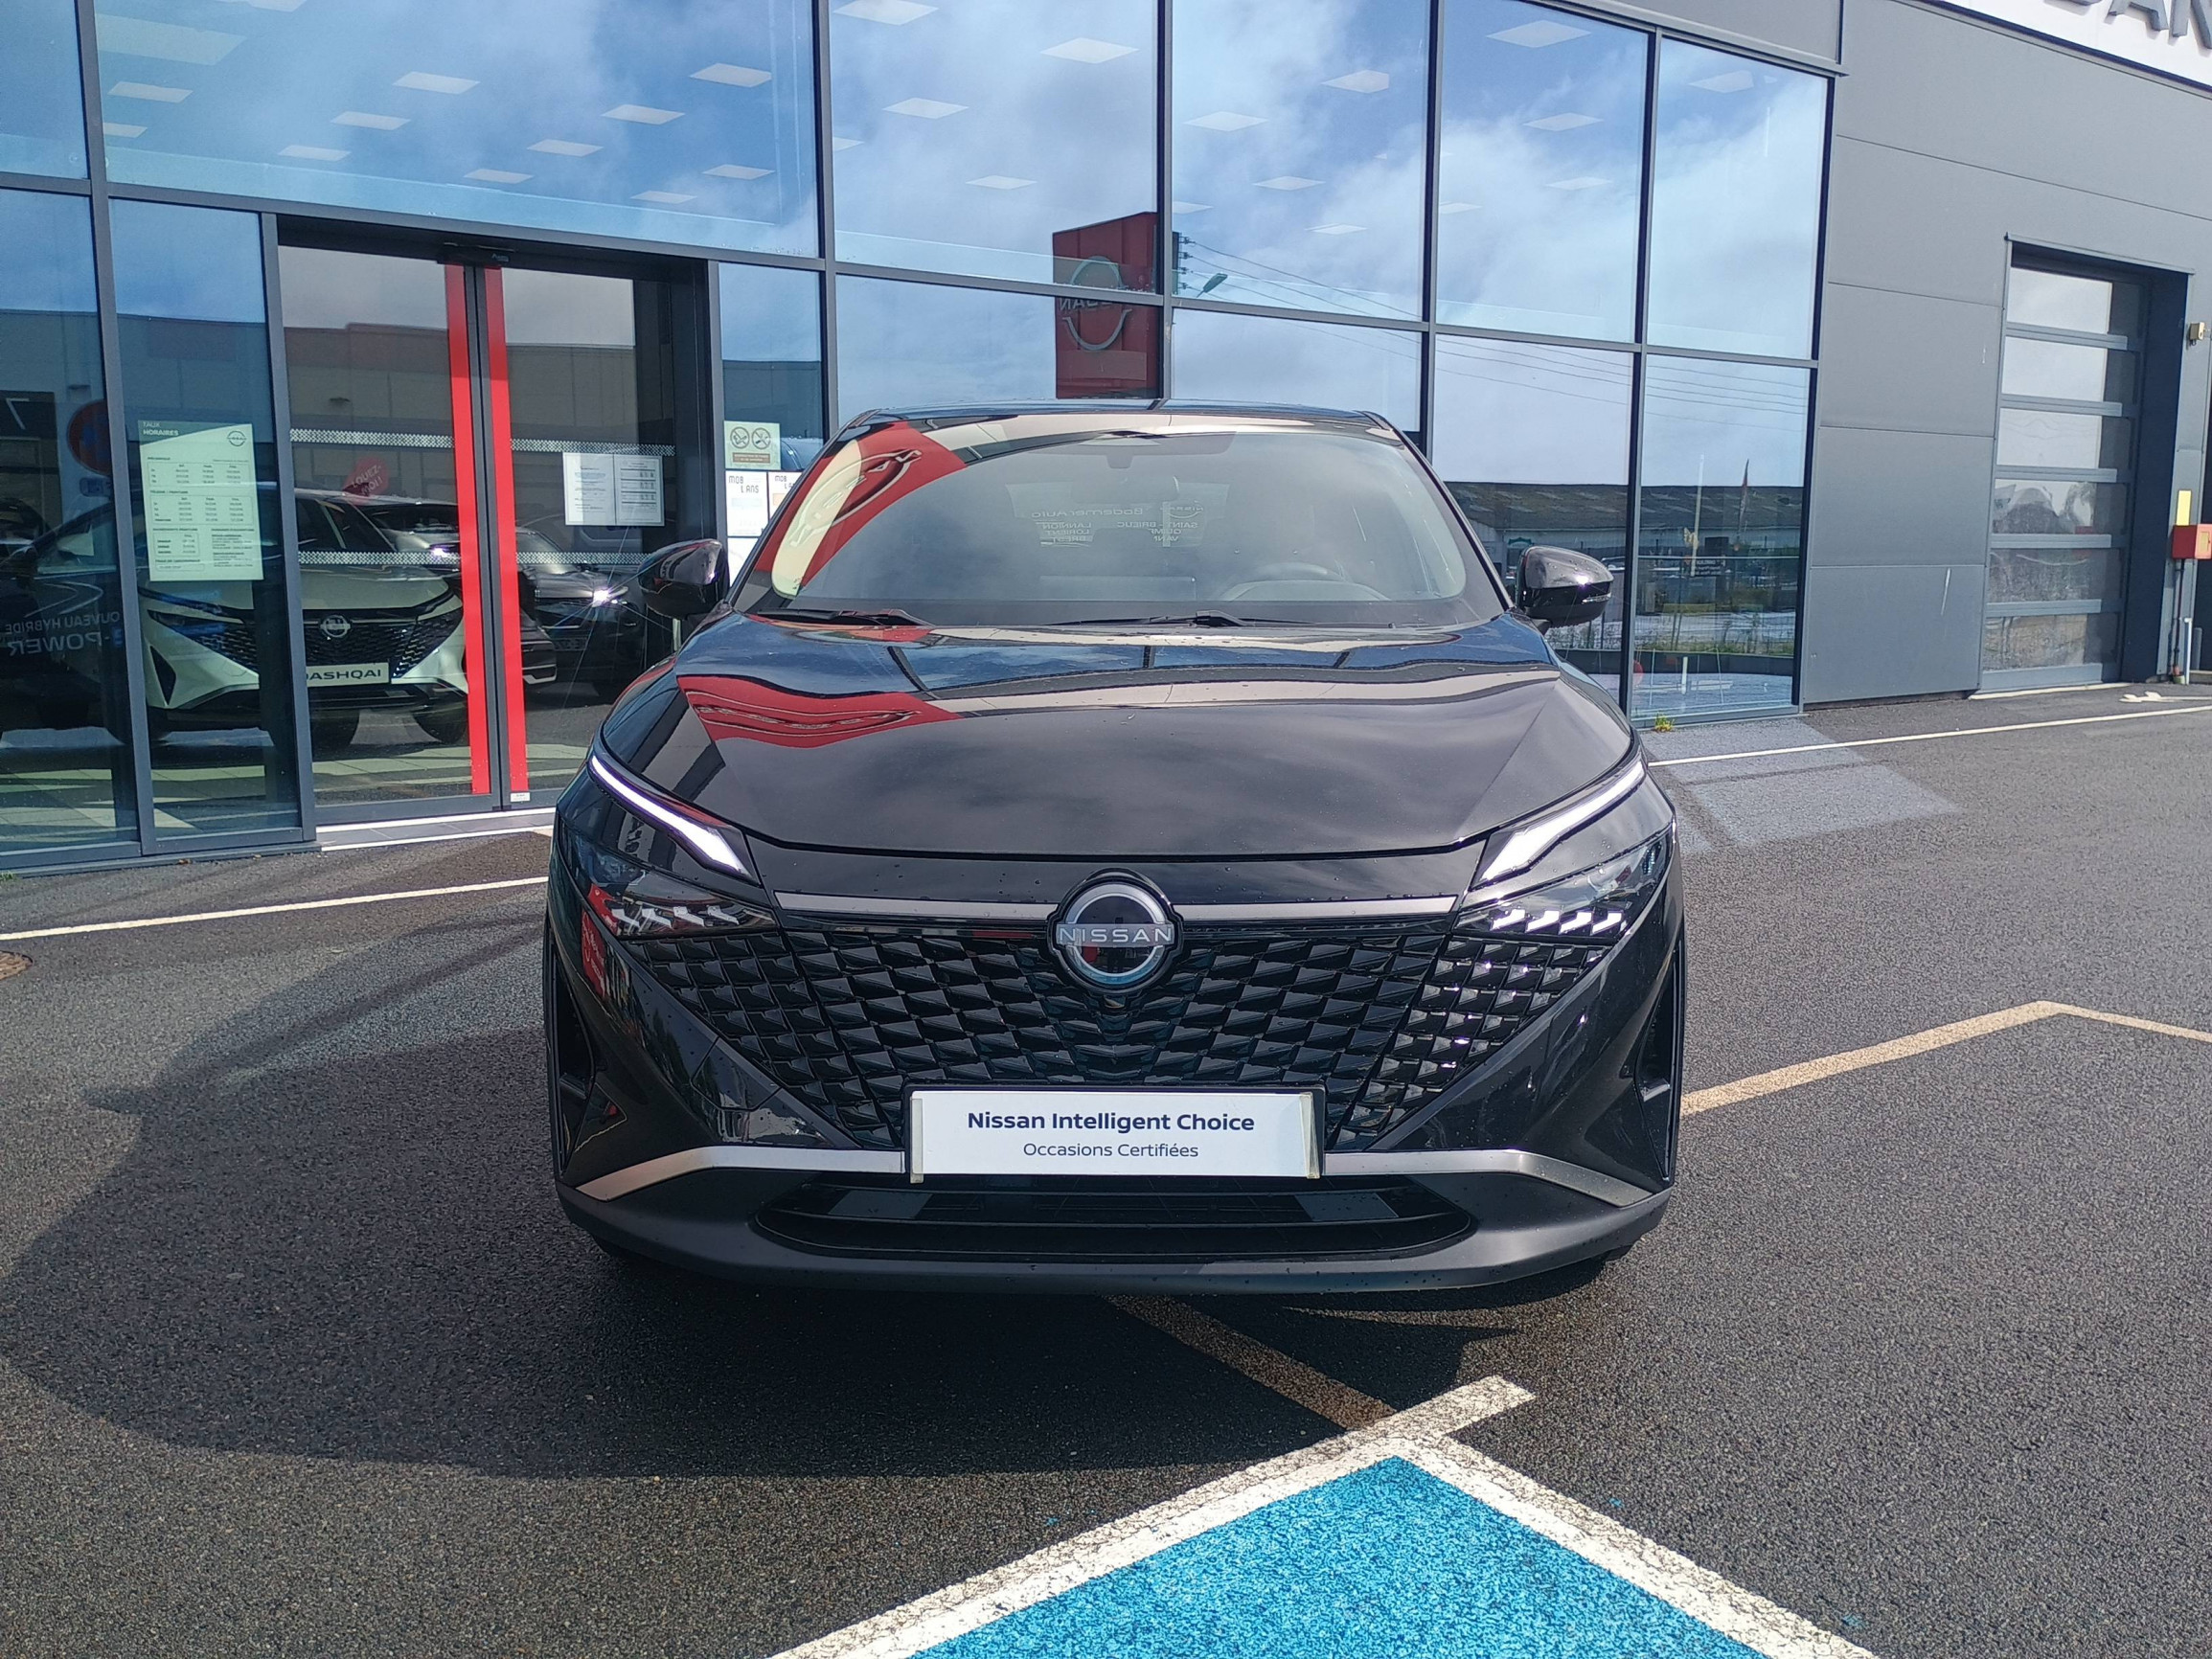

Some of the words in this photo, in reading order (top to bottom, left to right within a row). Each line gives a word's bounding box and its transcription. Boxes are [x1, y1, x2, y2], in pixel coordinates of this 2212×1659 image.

[306, 669, 381, 681] ASHQAI
[1059, 926, 1172, 943] NISSAN
[968, 1112, 1045, 1130] Nissan
[1052, 1112, 1170, 1134] Intelligent
[1176, 1113, 1255, 1131] Choice
[1023, 1142, 1113, 1157] Occasions
[1117, 1142, 1198, 1158] Certifiées
